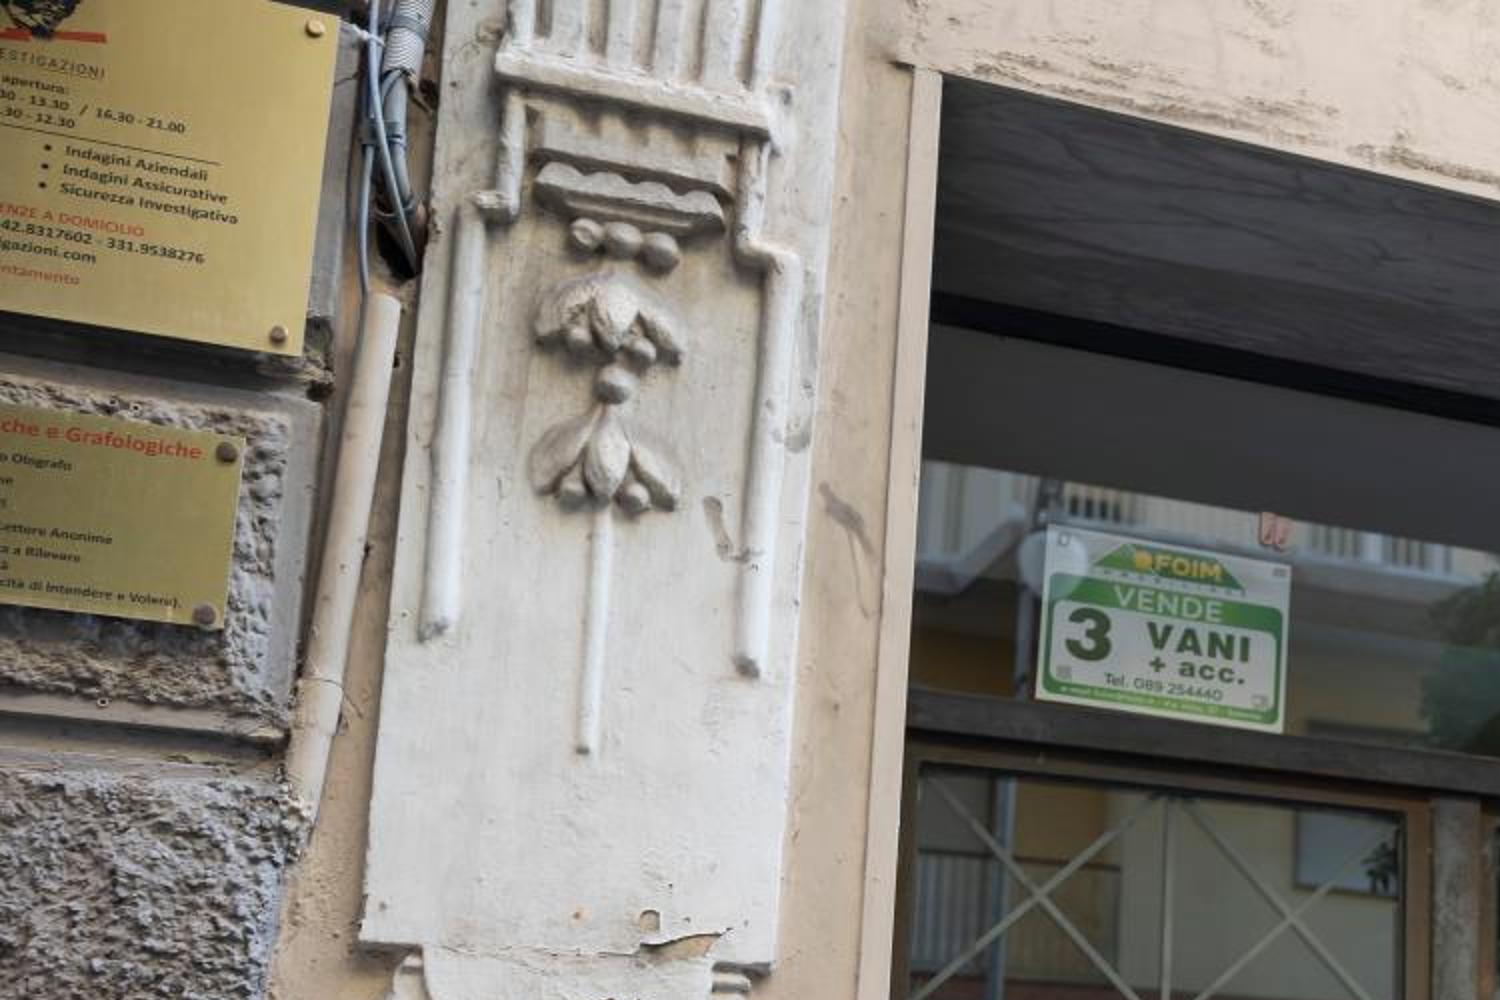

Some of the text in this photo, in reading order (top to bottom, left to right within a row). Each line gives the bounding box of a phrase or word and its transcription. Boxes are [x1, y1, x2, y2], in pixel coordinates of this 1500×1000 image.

[79, 104, 88, 117] /
[96, 107, 134, 124] 16.30
[146, 117, 186, 134] 21.00
[64, 145, 208, 181] Indagini Aziendali
[60, 183, 134, 206] Sicurezza
[62, 164, 228, 204] Indagini Assicurative
[43, 211, 53, 221] A
[65, 426, 203, 459] Grafologiche
[50, 527, 113, 545] Anonime
[1154, 553, 1223, 582] FOIM
[46, 581, 113, 600] Intendere
[1113, 584, 1224, 623] VENDE
[1065, 607, 1251, 663] 3 VANI
[1104, 672, 1128, 688] Tel.
[1179, 661, 1245, 685] acc.
